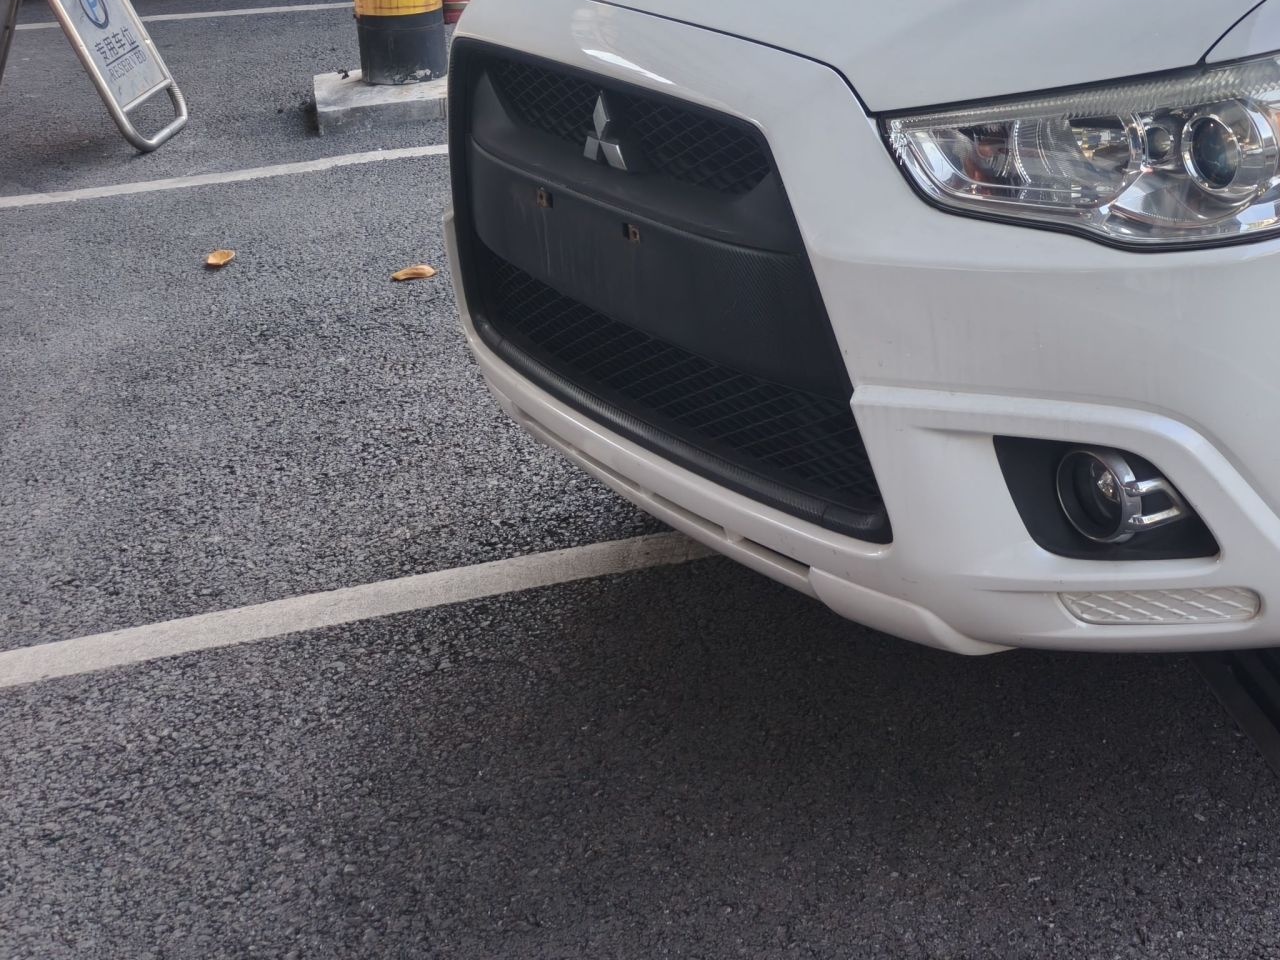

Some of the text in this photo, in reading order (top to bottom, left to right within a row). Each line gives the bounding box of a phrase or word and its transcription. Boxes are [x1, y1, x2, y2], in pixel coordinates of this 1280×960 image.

[94, 26, 137, 61] 专用车位
[109, 48, 148, 81] RESERVED
